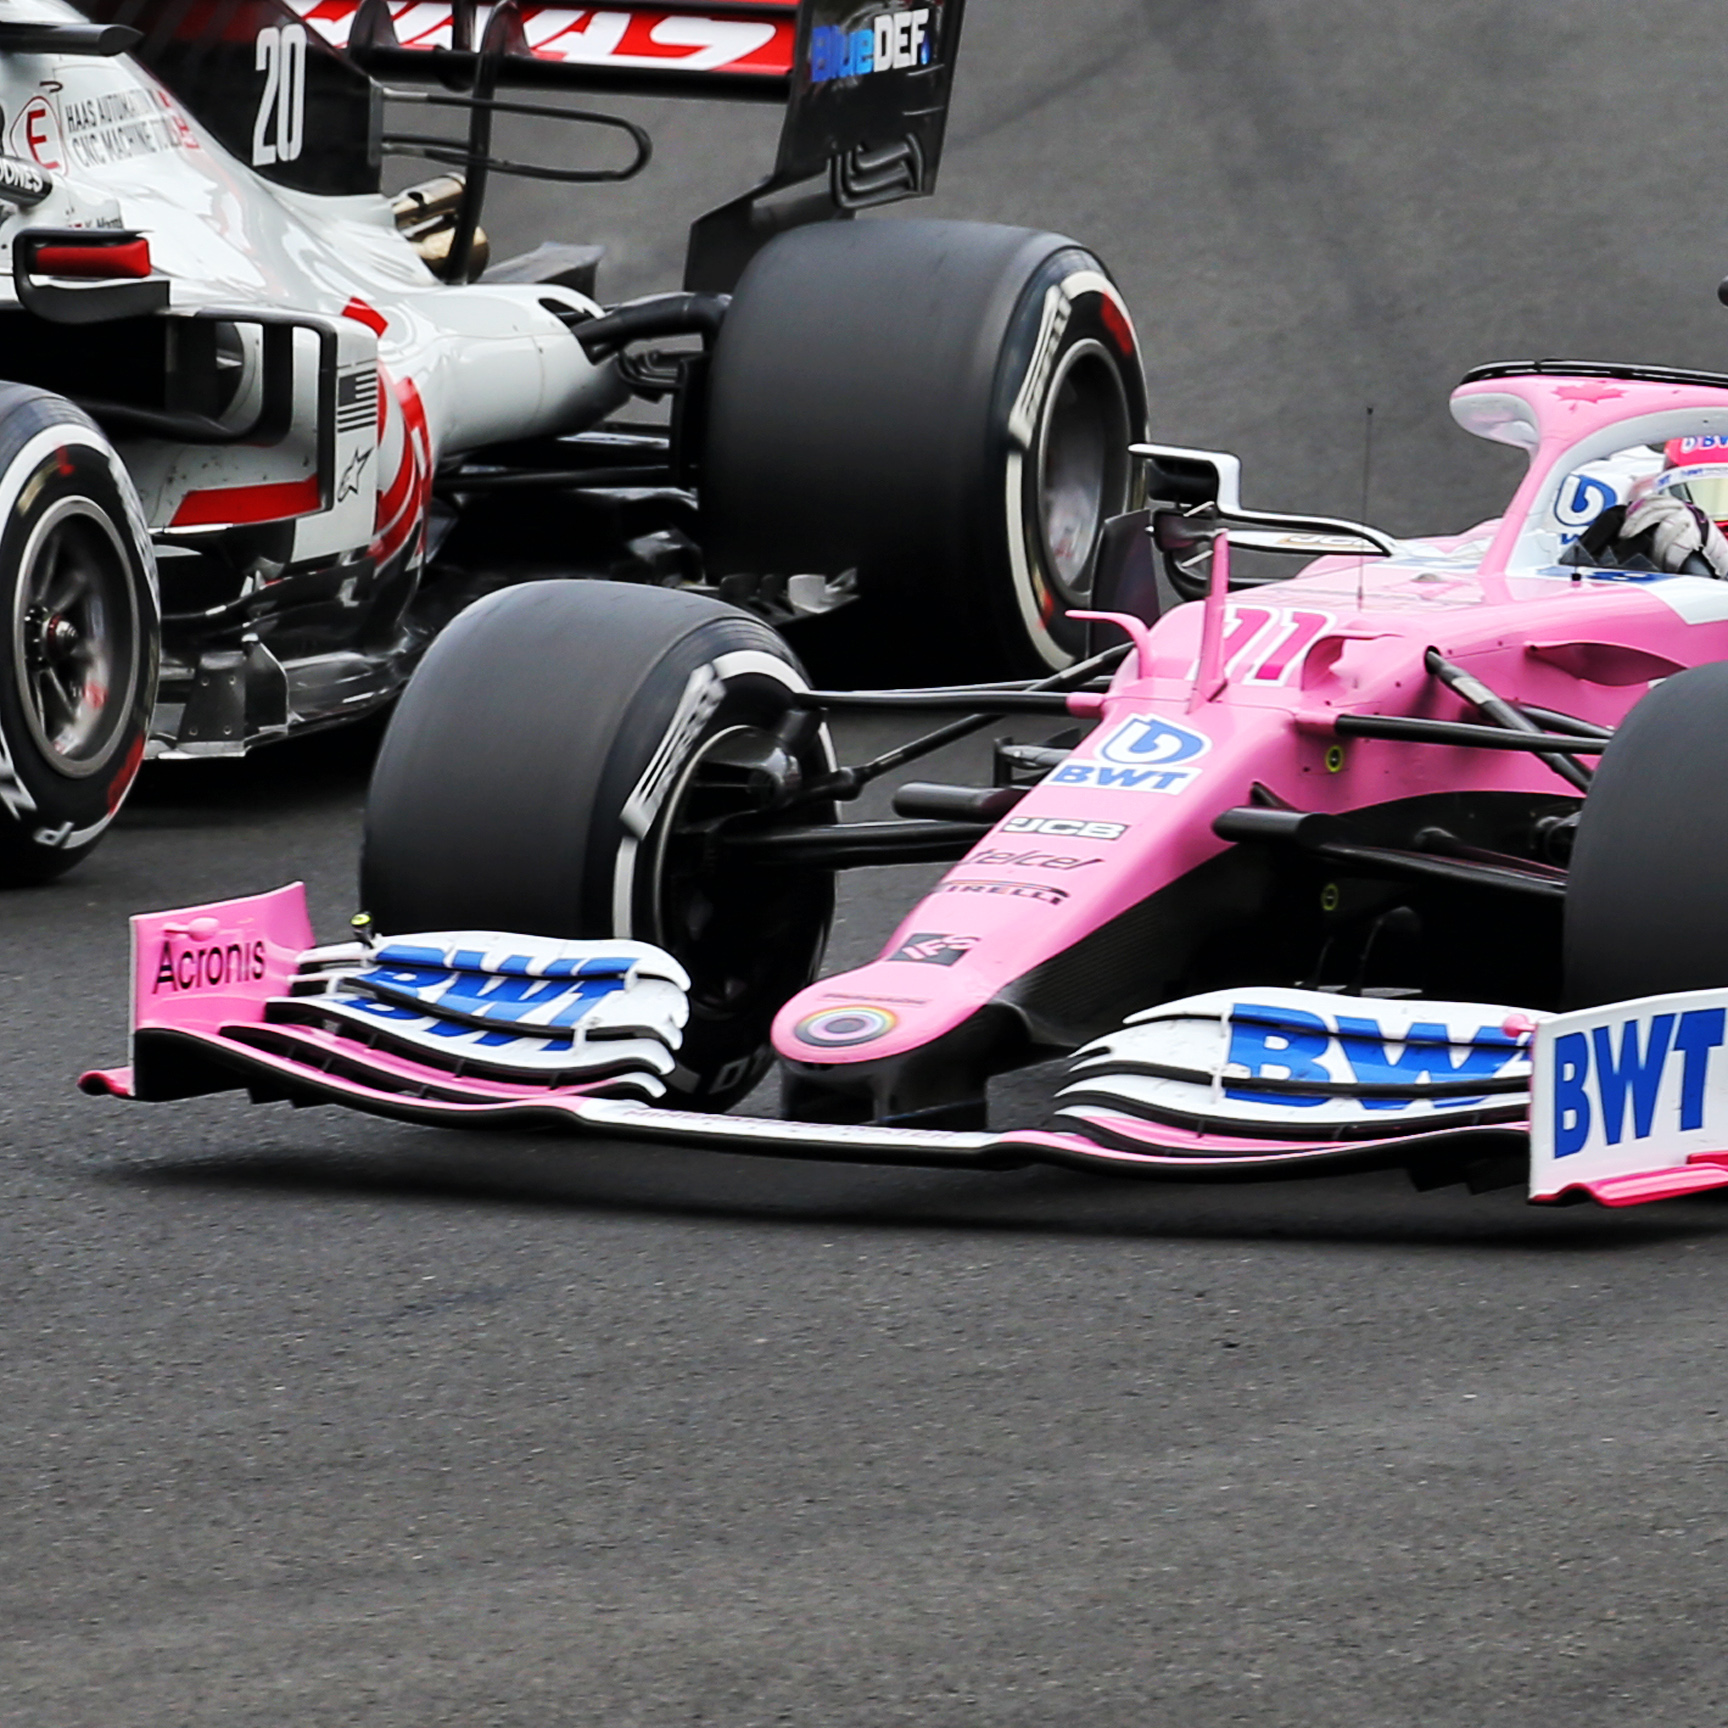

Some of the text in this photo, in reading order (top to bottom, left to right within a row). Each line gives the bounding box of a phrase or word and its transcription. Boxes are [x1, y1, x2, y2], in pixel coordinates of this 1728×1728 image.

[253, 24, 307, 167] 20
[1186, 605, 1336, 686] 11
[1049, 764, 1188, 789] BWT
[1001, 817, 1125, 840] JCB
[935, 879, 1071, 906] PIRELLI
[152, 939, 266, 994] Acronis
[1224, 1002, 1534, 1111] BW
[1553, 1007, 1727, 1160] BWT
